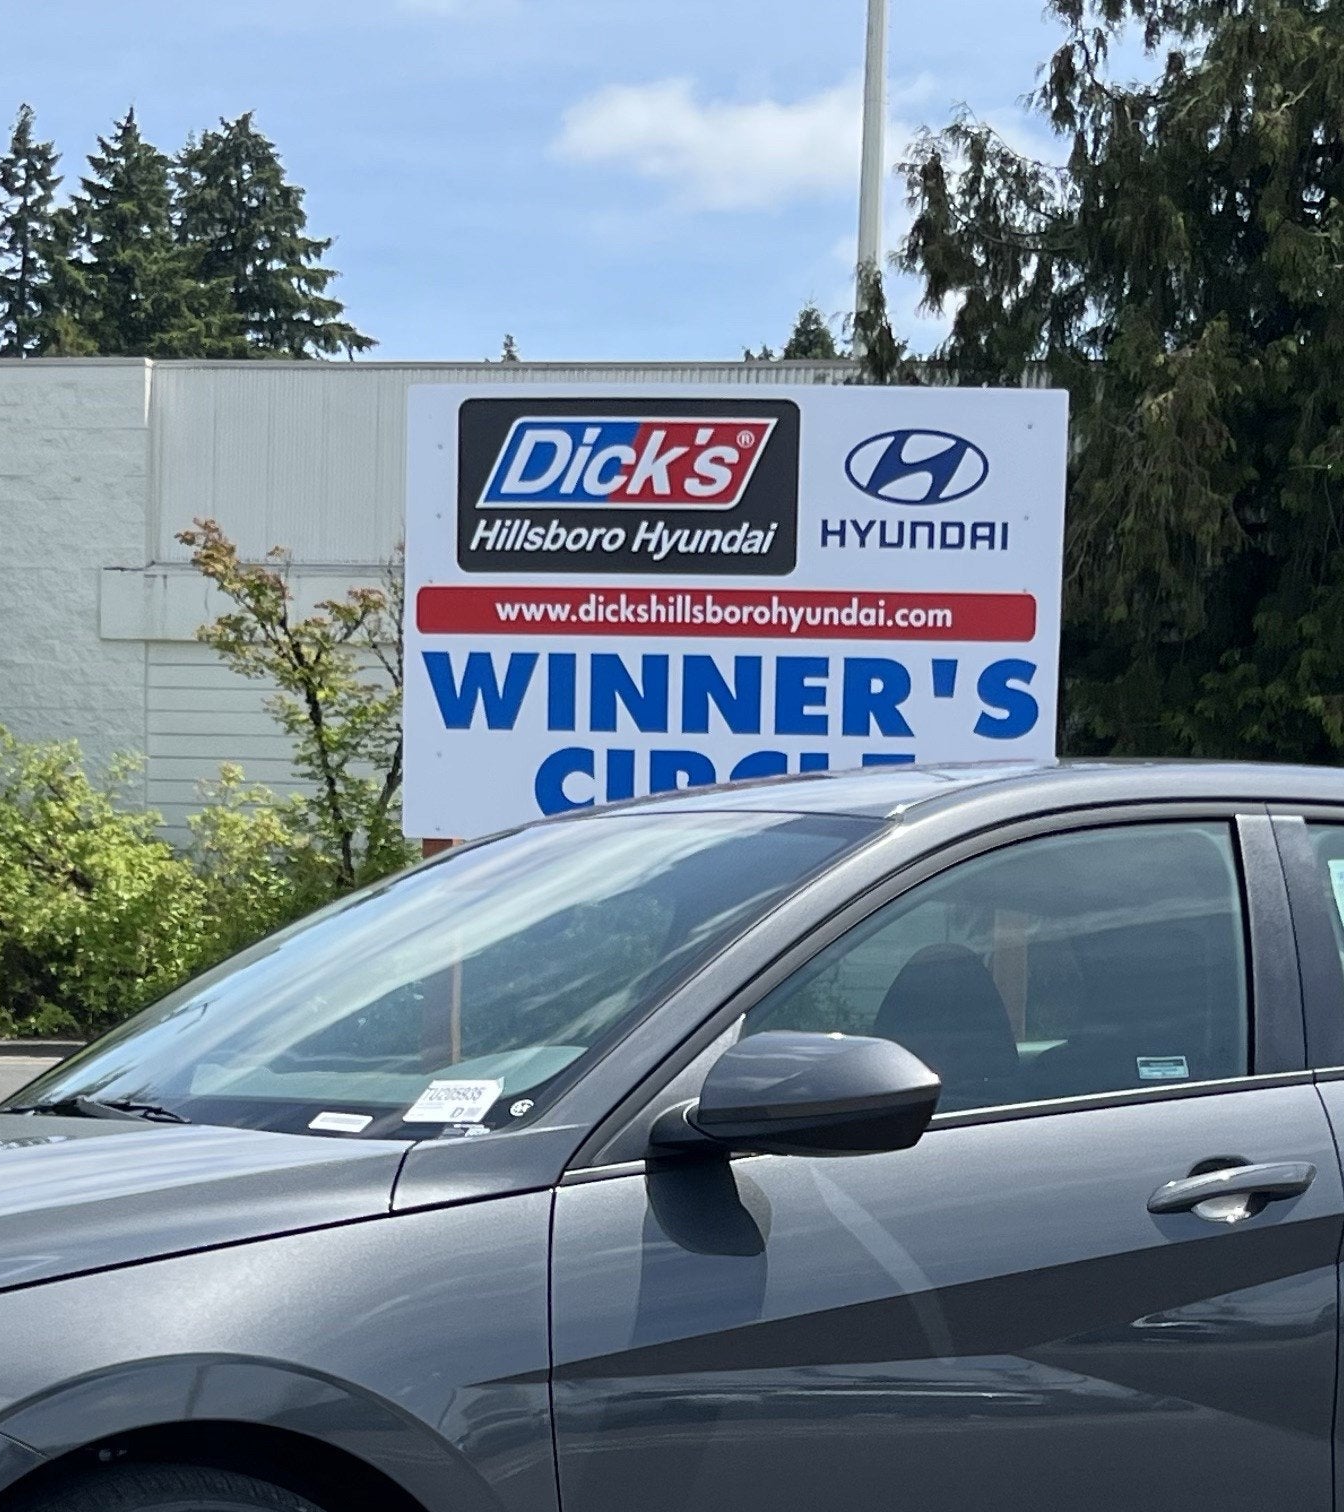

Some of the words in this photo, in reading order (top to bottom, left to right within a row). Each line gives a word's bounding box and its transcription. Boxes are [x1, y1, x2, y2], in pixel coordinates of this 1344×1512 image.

[499, 427, 742, 496] Dick's
[469, 519, 624, 552] Hillsboro
[632, 520, 779, 560] Hyundai
[821, 519, 1009, 551] HYUNDAI
[495, 593, 953, 634] www.dickshillsborohyundai.com
[422, 652, 1039, 740] WINNER'S
